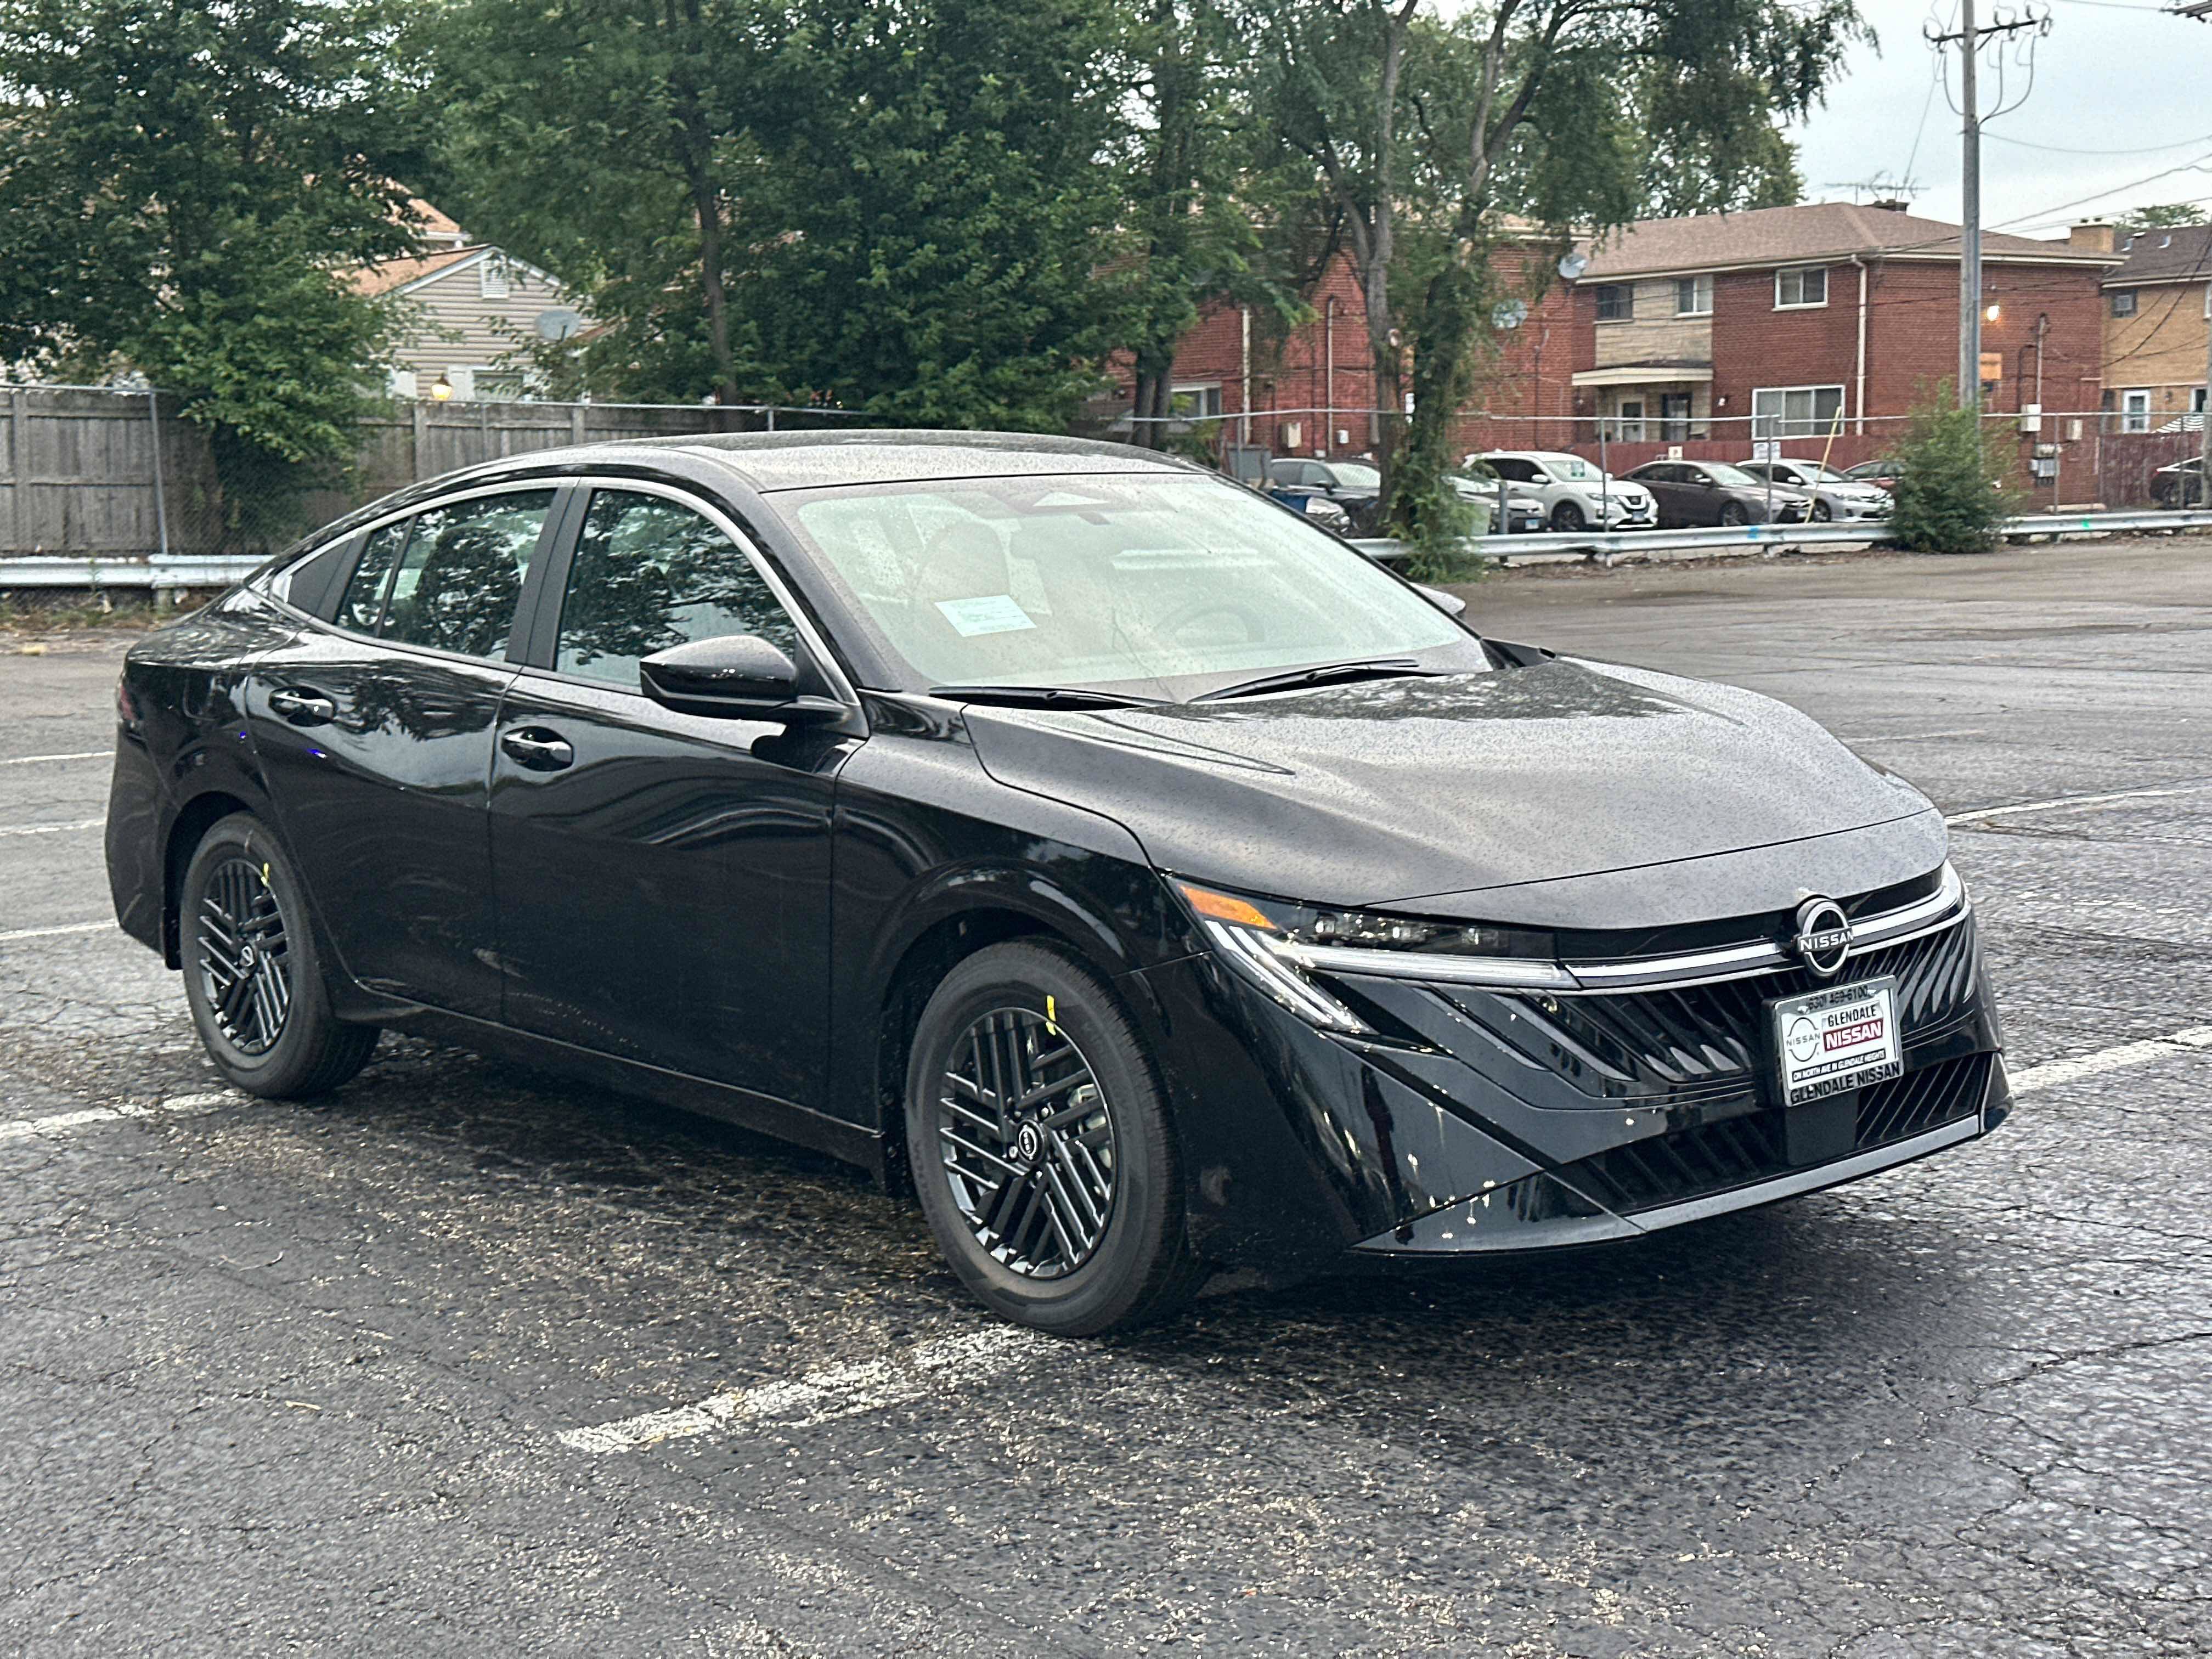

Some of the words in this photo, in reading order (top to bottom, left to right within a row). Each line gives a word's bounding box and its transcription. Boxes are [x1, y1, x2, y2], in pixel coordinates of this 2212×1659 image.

[1800, 931, 1854, 950] NISSAN
[1828, 1005, 1876, 1027] GLENDALE
[1786, 1031, 1820, 1047] NISSAN
[1825, 1020, 1881, 1049] NISSAN
[1791, 1076, 1854, 1103] GLENDALE
[1857, 1061, 1899, 1085] NISSAN
